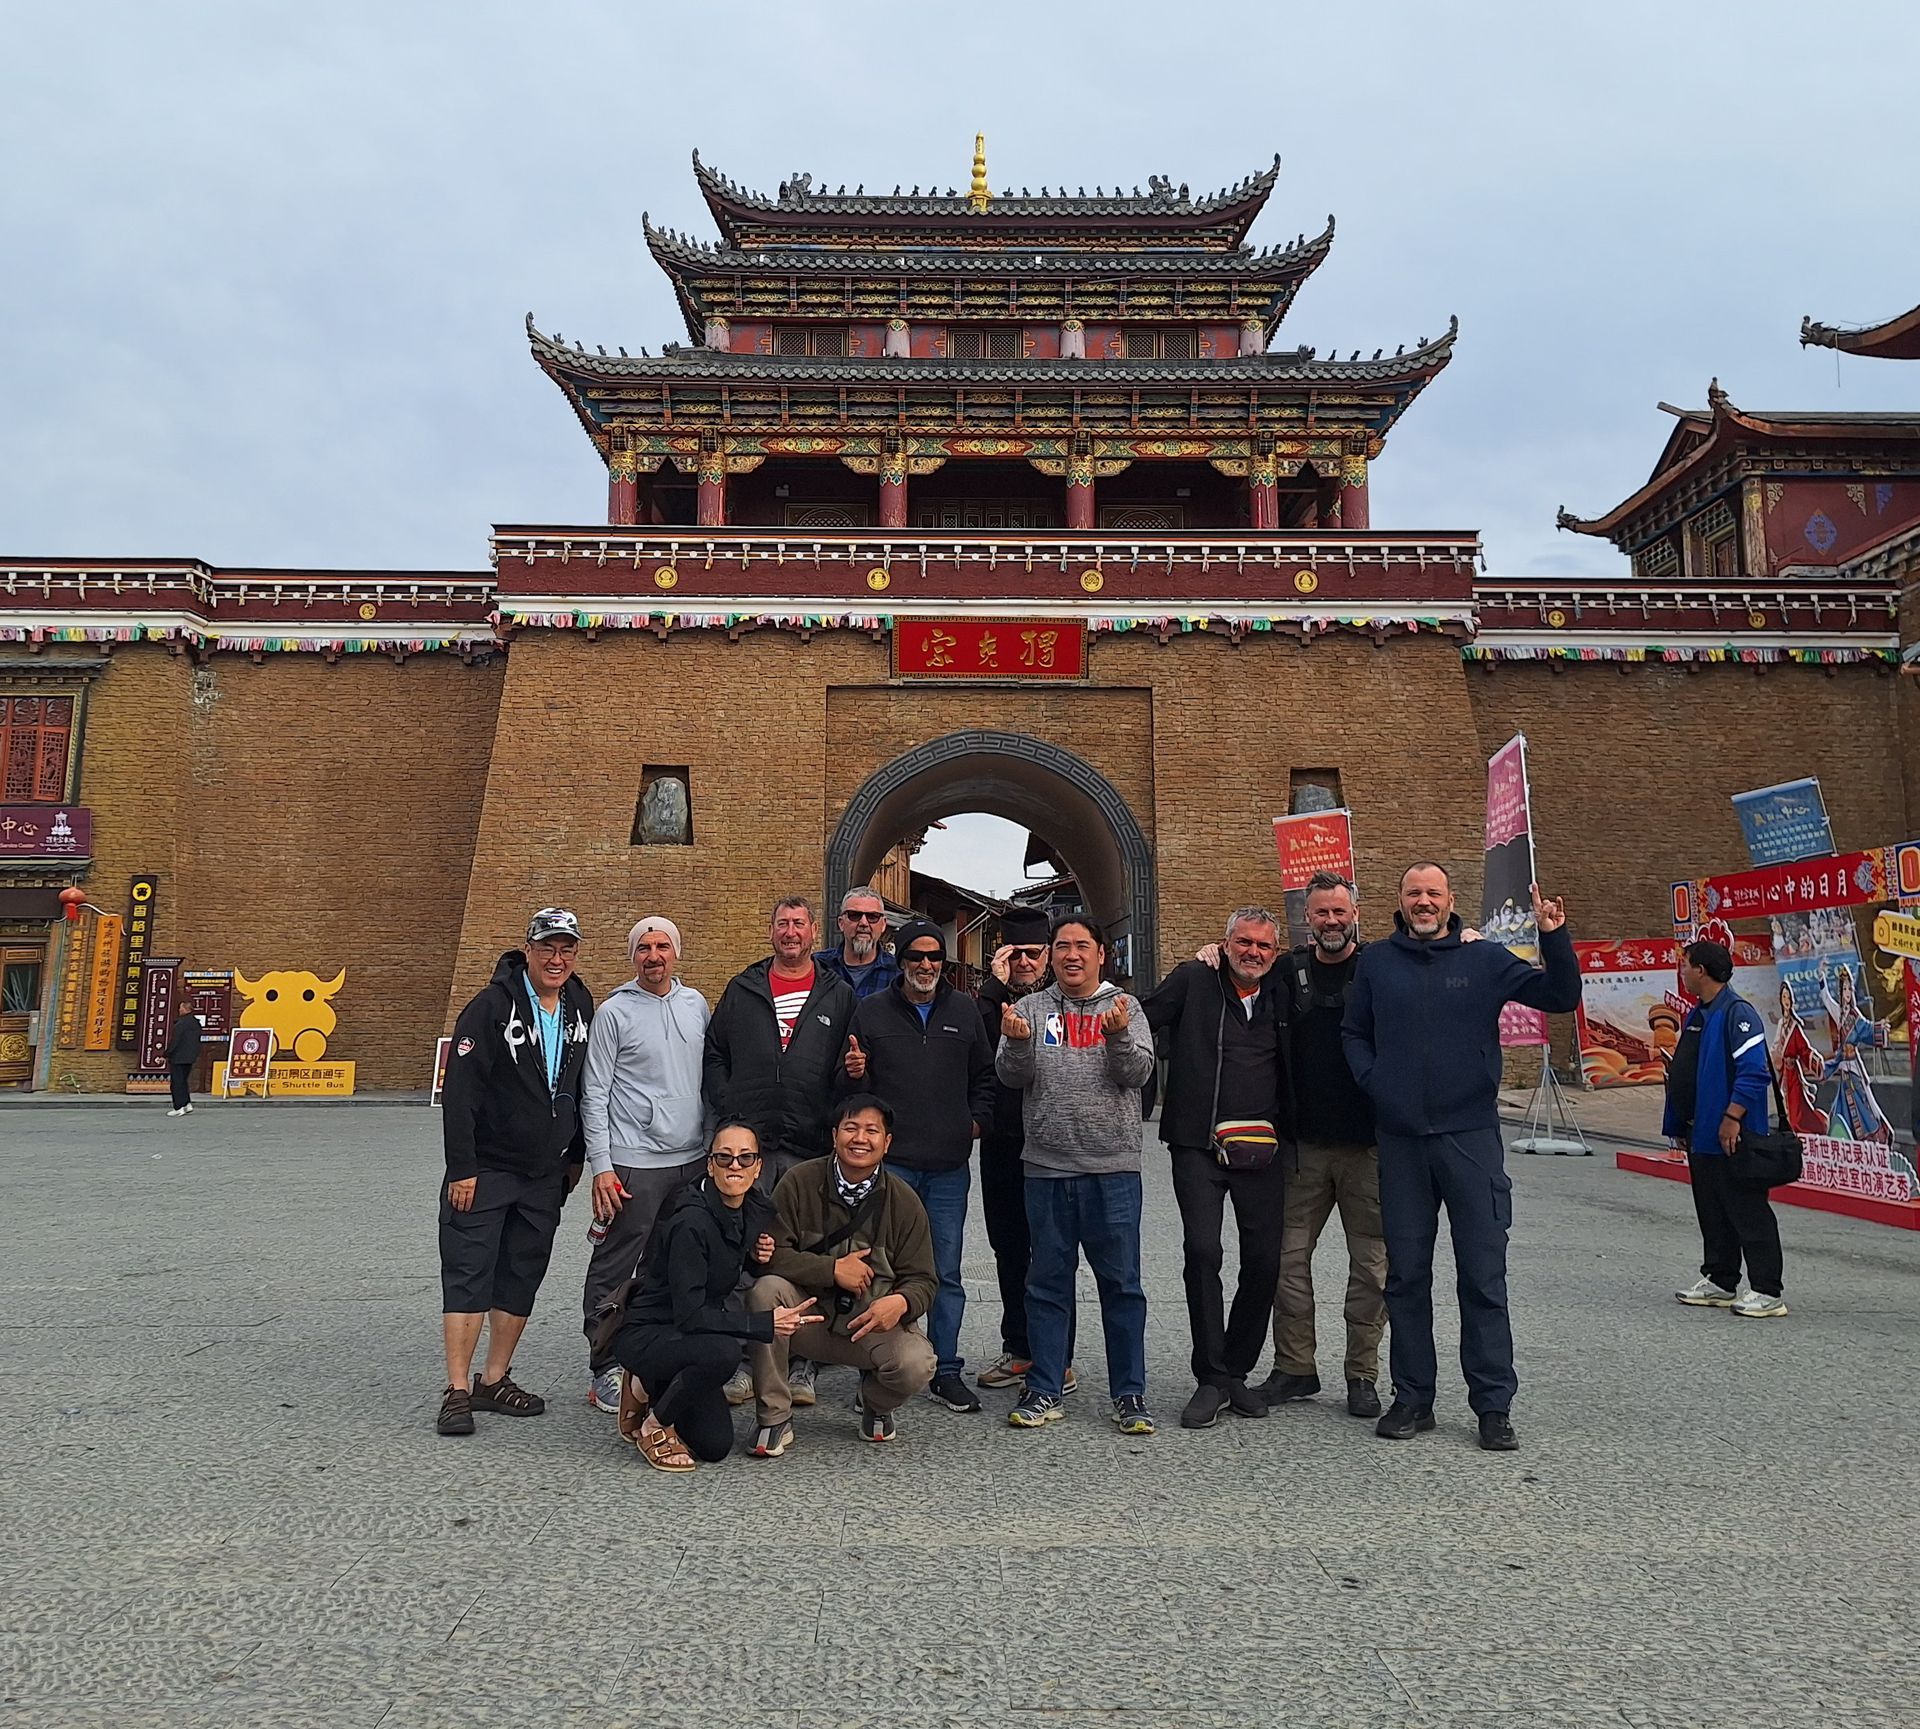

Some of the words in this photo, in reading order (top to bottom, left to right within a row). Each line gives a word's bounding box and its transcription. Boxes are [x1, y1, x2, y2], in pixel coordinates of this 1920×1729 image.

[1766, 868, 1847, 905] 心中的日月
[282, 1081, 321, 1089] Shuttle
[1801, 1161, 1909, 1198] 高的大型室内演艺秀
